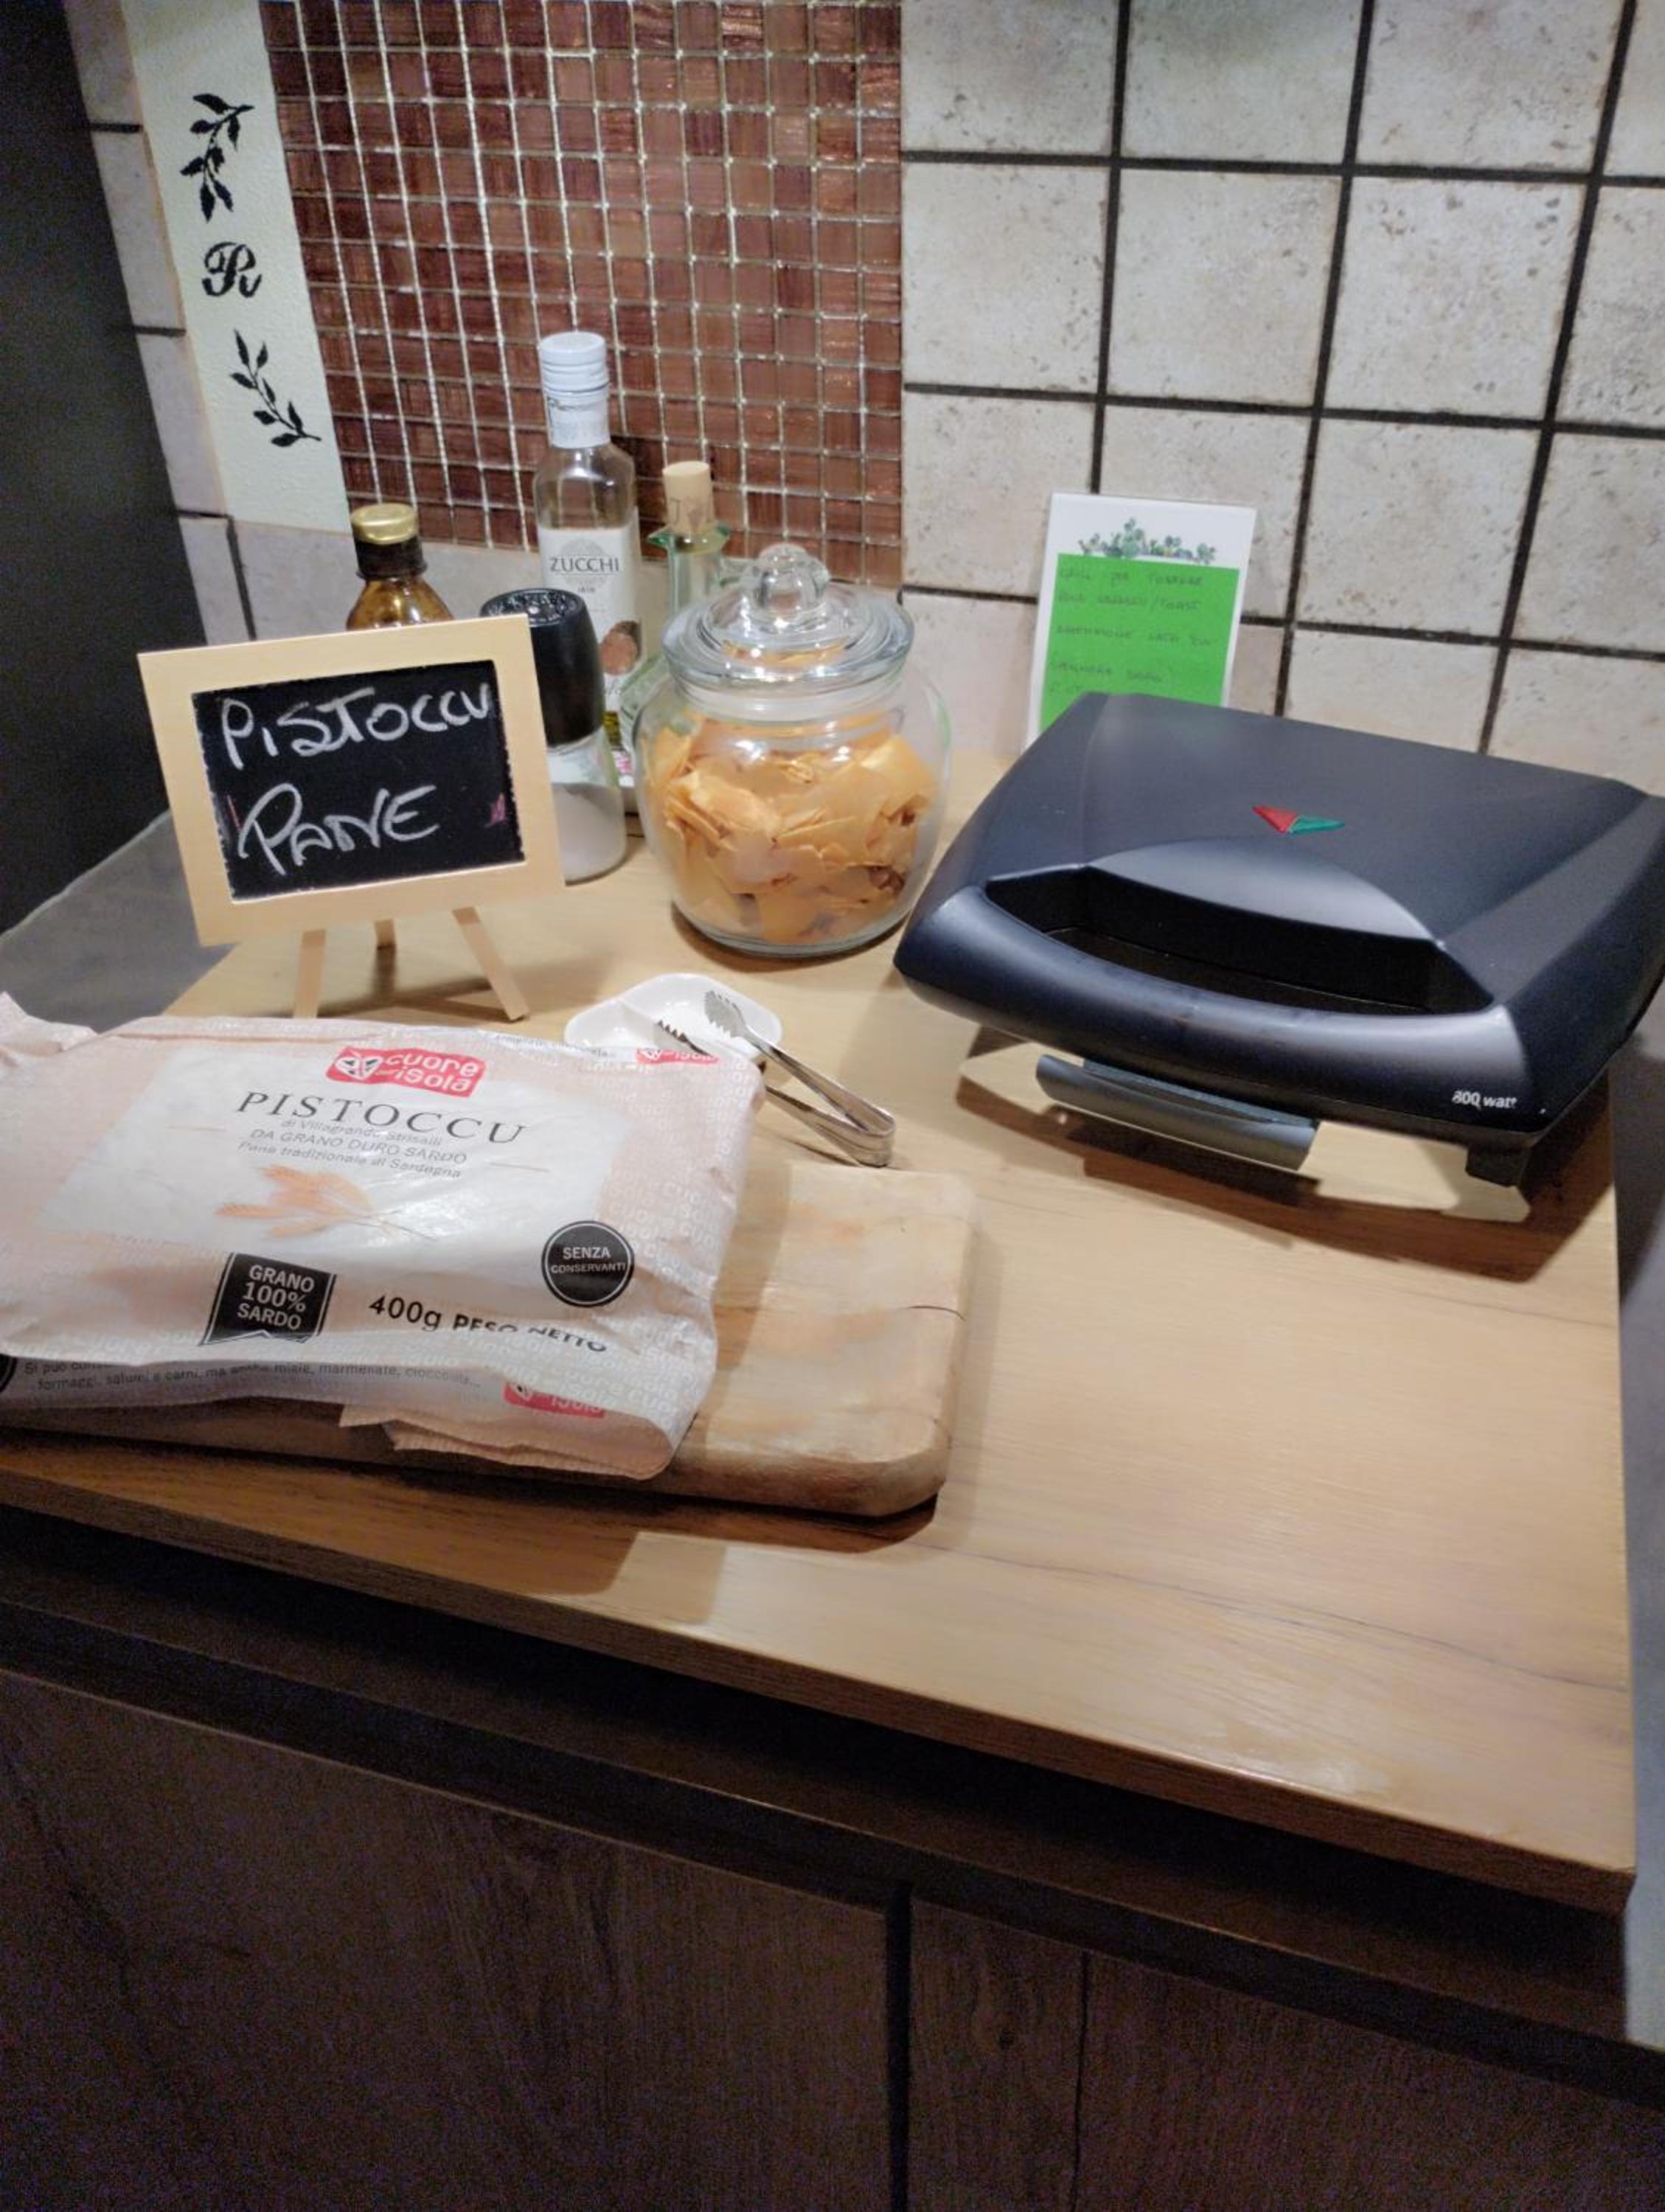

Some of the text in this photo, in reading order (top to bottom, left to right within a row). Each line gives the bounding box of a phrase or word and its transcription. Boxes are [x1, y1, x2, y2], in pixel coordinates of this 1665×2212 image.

[549, 556, 619, 573] ZUCCHI
[221, 682, 490, 770] PISTOCCU
[237, 782, 440, 875] PANE
[385, 1053, 479, 1077] cuore
[395, 1066, 473, 1093] isola
[235, 1091, 528, 1144] PISTOCCU
[236, 1140, 462, 1180] Pane tradizionale di Sardegna
[249, 1128, 468, 1165] DA GRANO DURO SARDO
[562, 1245, 611, 1260] SENZA
[248, 1264, 316, 1294] GRANO
[550, 1261, 627, 1276] CONSERVANTI
[242, 1281, 307, 1313] 100%
[237, 1301, 302, 1330] SARDO
[368, 1295, 442, 1332] 400g
